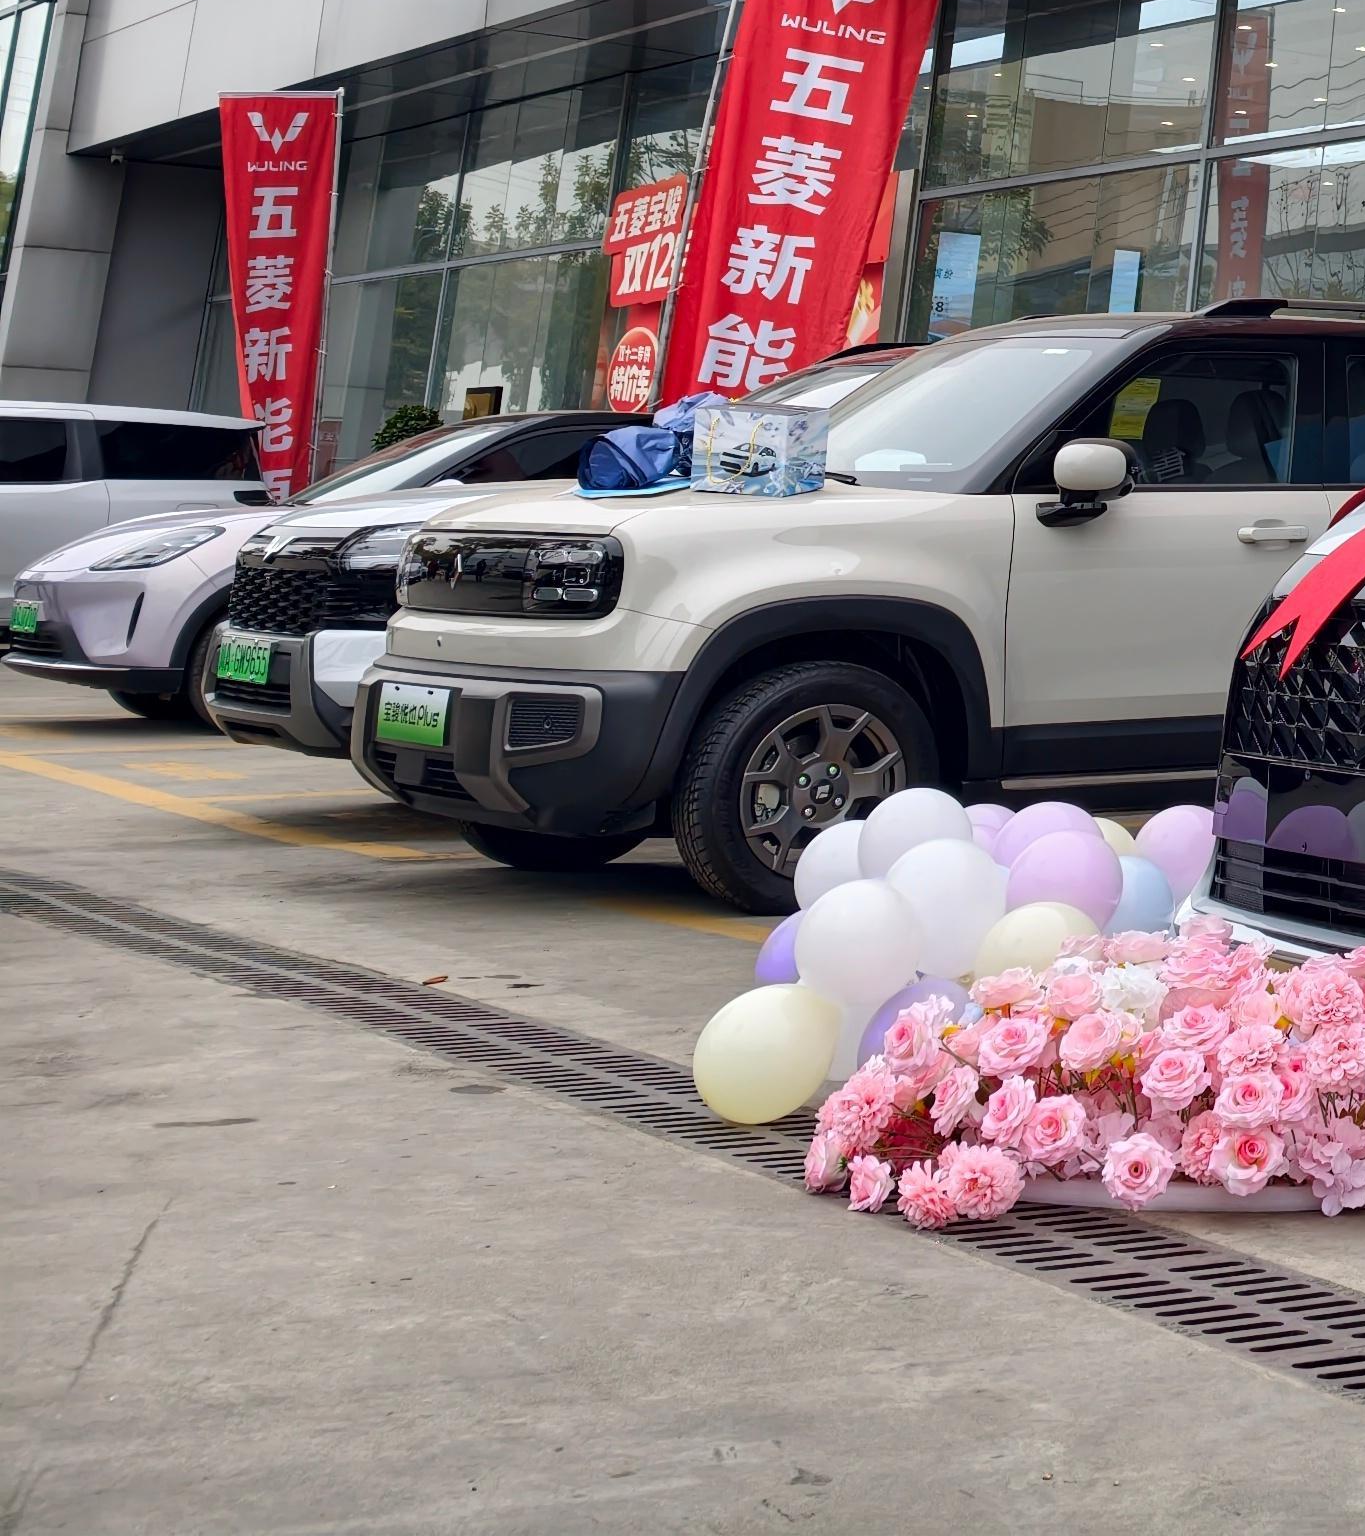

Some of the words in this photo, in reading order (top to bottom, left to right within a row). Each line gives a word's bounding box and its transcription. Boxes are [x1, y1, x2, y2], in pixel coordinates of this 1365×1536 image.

[781, 13, 887, 45] WULING
[247, 160, 308, 173] WULING
[610, 185, 683, 243] 五菱宝骏
[609, 363, 651, 403] 特价车
